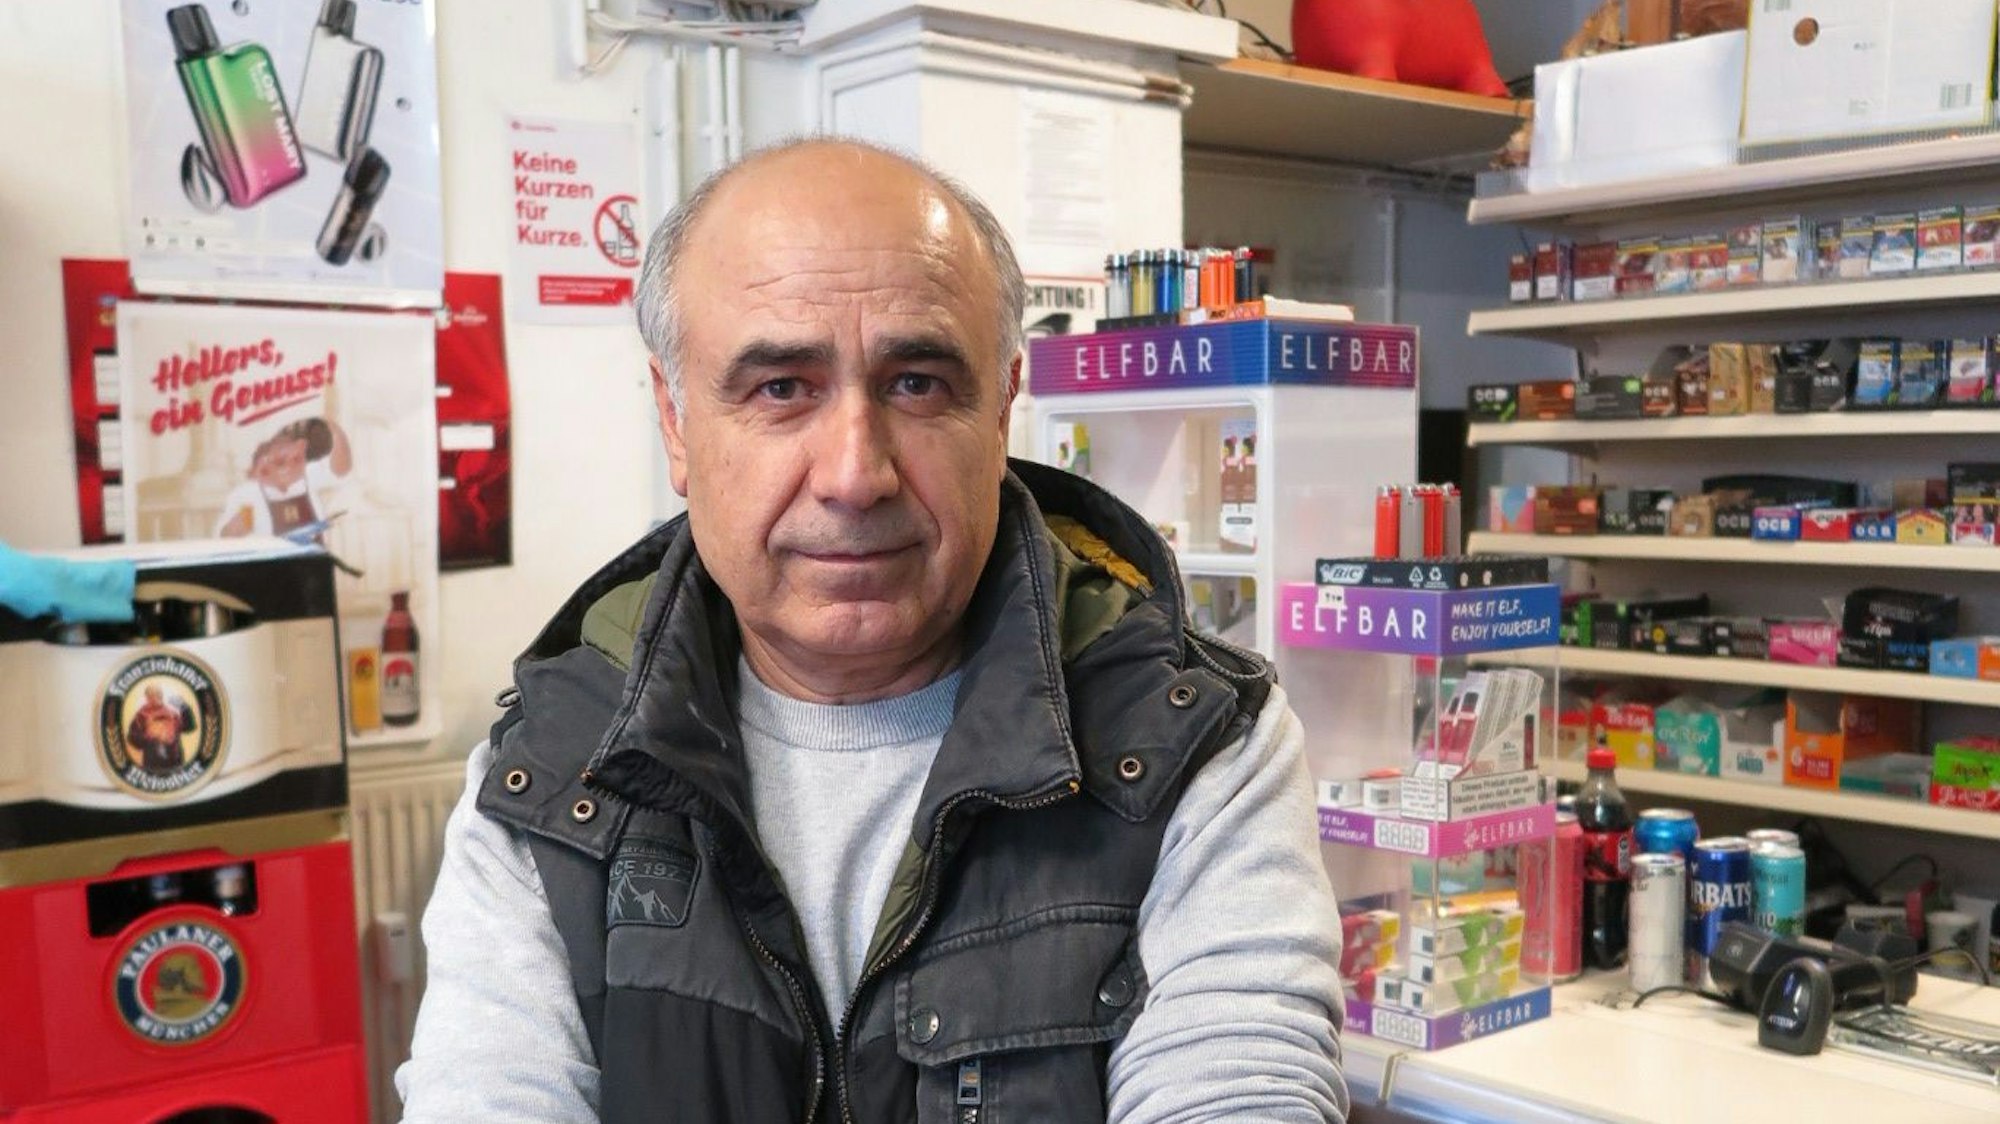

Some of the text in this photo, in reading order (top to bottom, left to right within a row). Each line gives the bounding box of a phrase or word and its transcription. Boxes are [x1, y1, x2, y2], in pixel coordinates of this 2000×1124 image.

[274, 116, 302, 169] MARY
[512, 151, 577, 175] Keine
[514, 176, 594, 199] Kurzen
[516, 201, 550, 221] für
[518, 226, 590, 248] Kurze.
[1023, 284, 1085, 309] CHTUNG
[152, 339, 284, 393] Hellers,
[1076, 337, 1213, 381] ELFBAR
[1281, 334, 1412, 374] ELFBAR
[150, 352, 338, 436] ein Genuss!
[1758, 518, 1791, 531] OCB
[1855, 524, 1892, 537] OCB
[1332, 567, 1361, 579] BIC
[1291, 601, 1427, 639] ELFBAR
[1451, 602, 1483, 619] MAKE
[1451, 616, 1551, 642] ENJOY YOURSELF!
[1482, 818, 1534, 844] ELFBAR
[122, 925, 234, 978] PAULANER
[1479, 1002, 1531, 1033] ELFBAR
